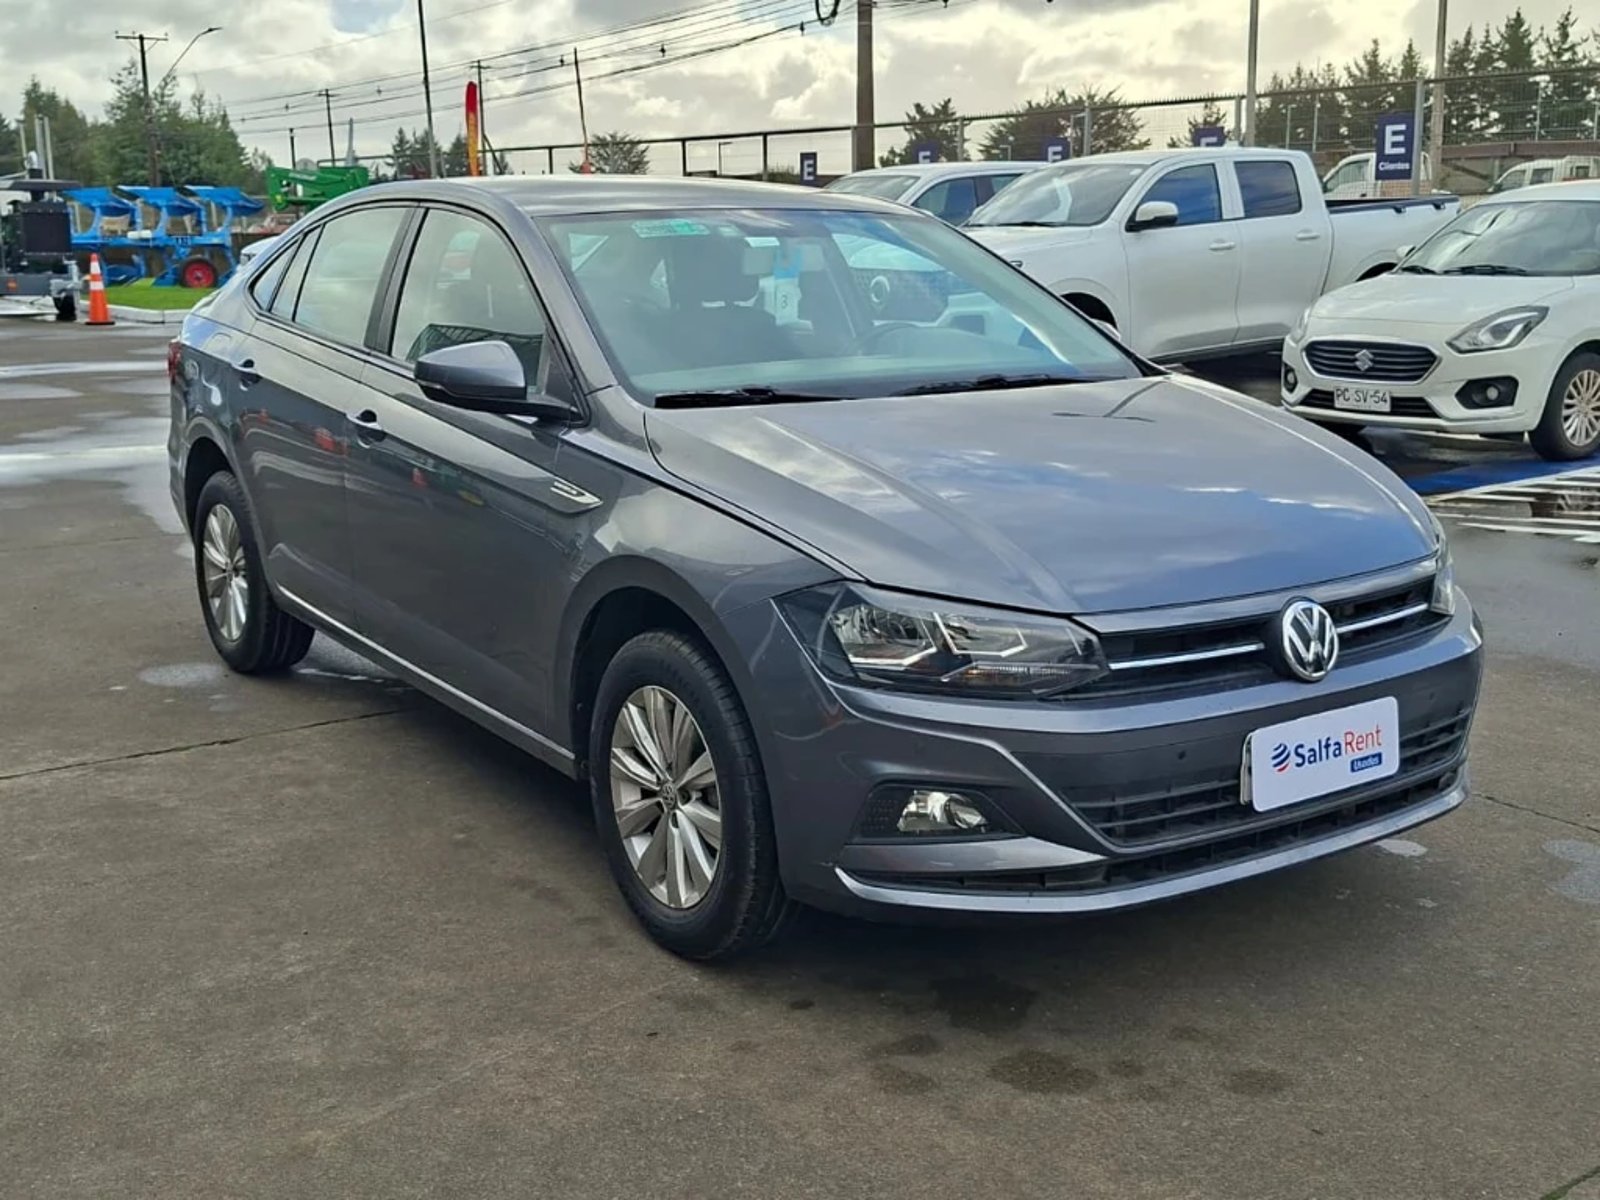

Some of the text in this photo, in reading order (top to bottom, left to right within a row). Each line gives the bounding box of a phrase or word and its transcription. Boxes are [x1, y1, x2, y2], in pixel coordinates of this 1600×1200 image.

[1384, 124, 1407, 155] E
[803, 160, 815, 181] E
[1294, 724, 1383, 768] SalfaRent
